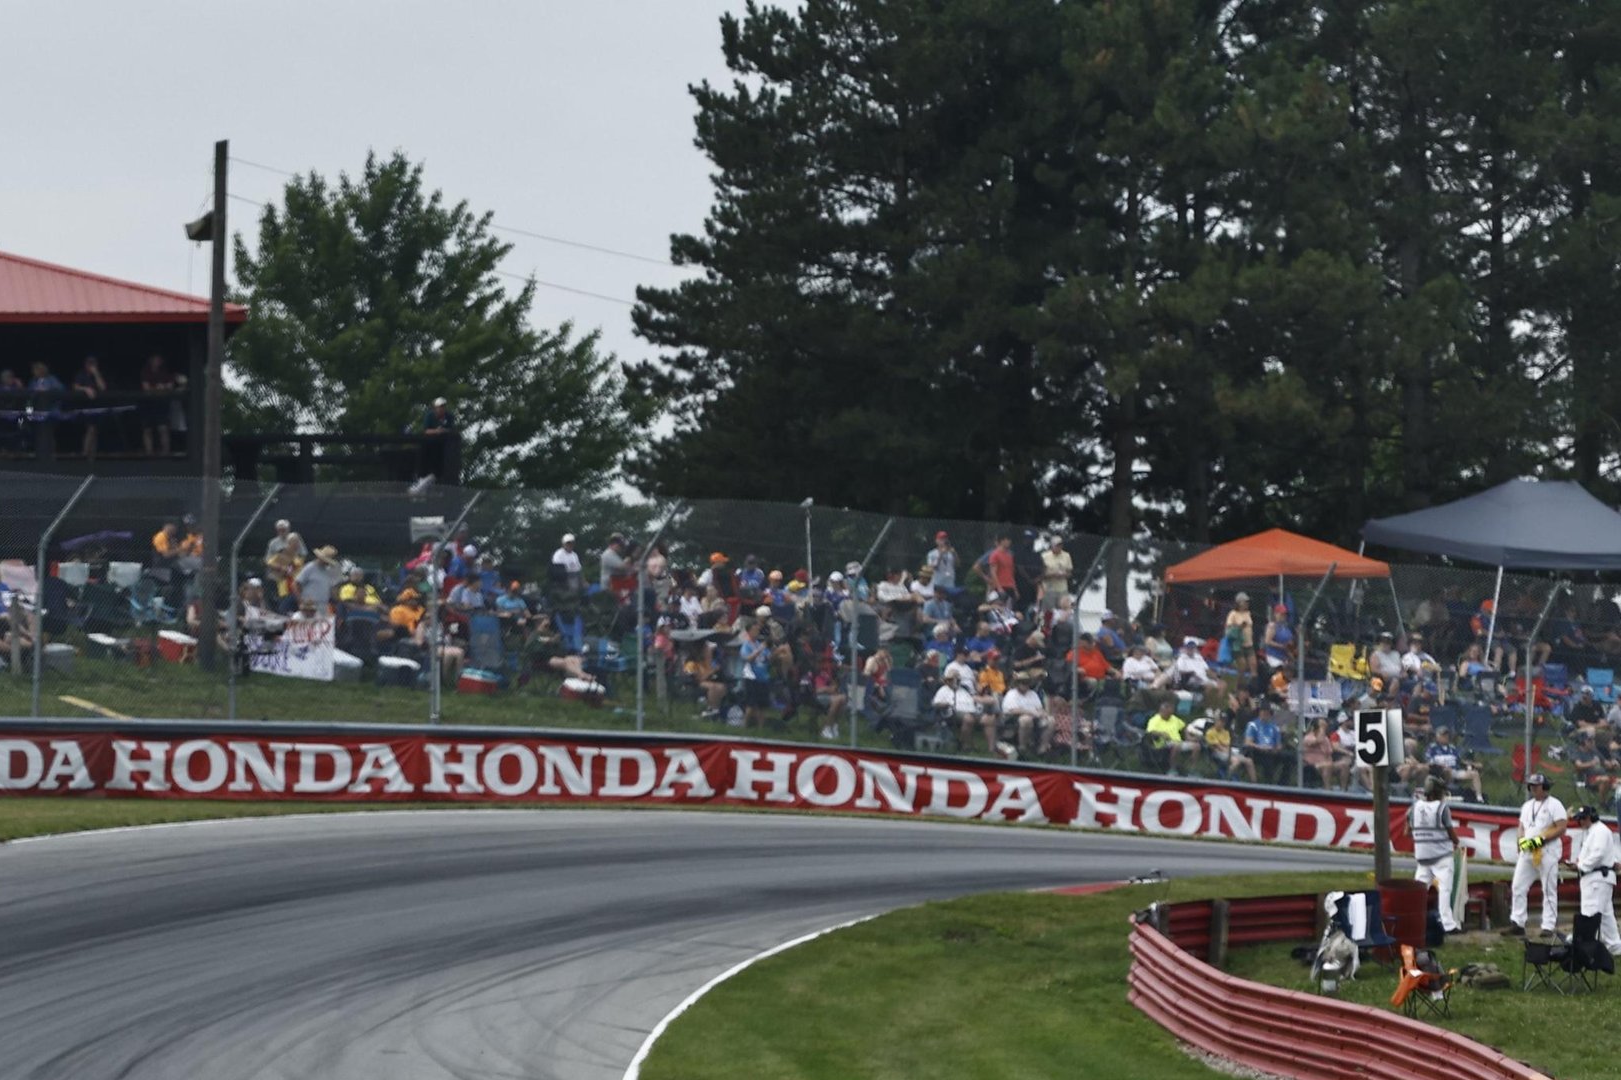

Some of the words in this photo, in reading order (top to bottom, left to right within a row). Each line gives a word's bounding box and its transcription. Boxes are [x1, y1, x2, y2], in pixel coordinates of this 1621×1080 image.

[1358, 711, 1385, 765] 5
[105, 739, 417, 795] HONDA
[423, 742, 716, 799] HONDA
[726, 749, 1051, 825] HONDA
